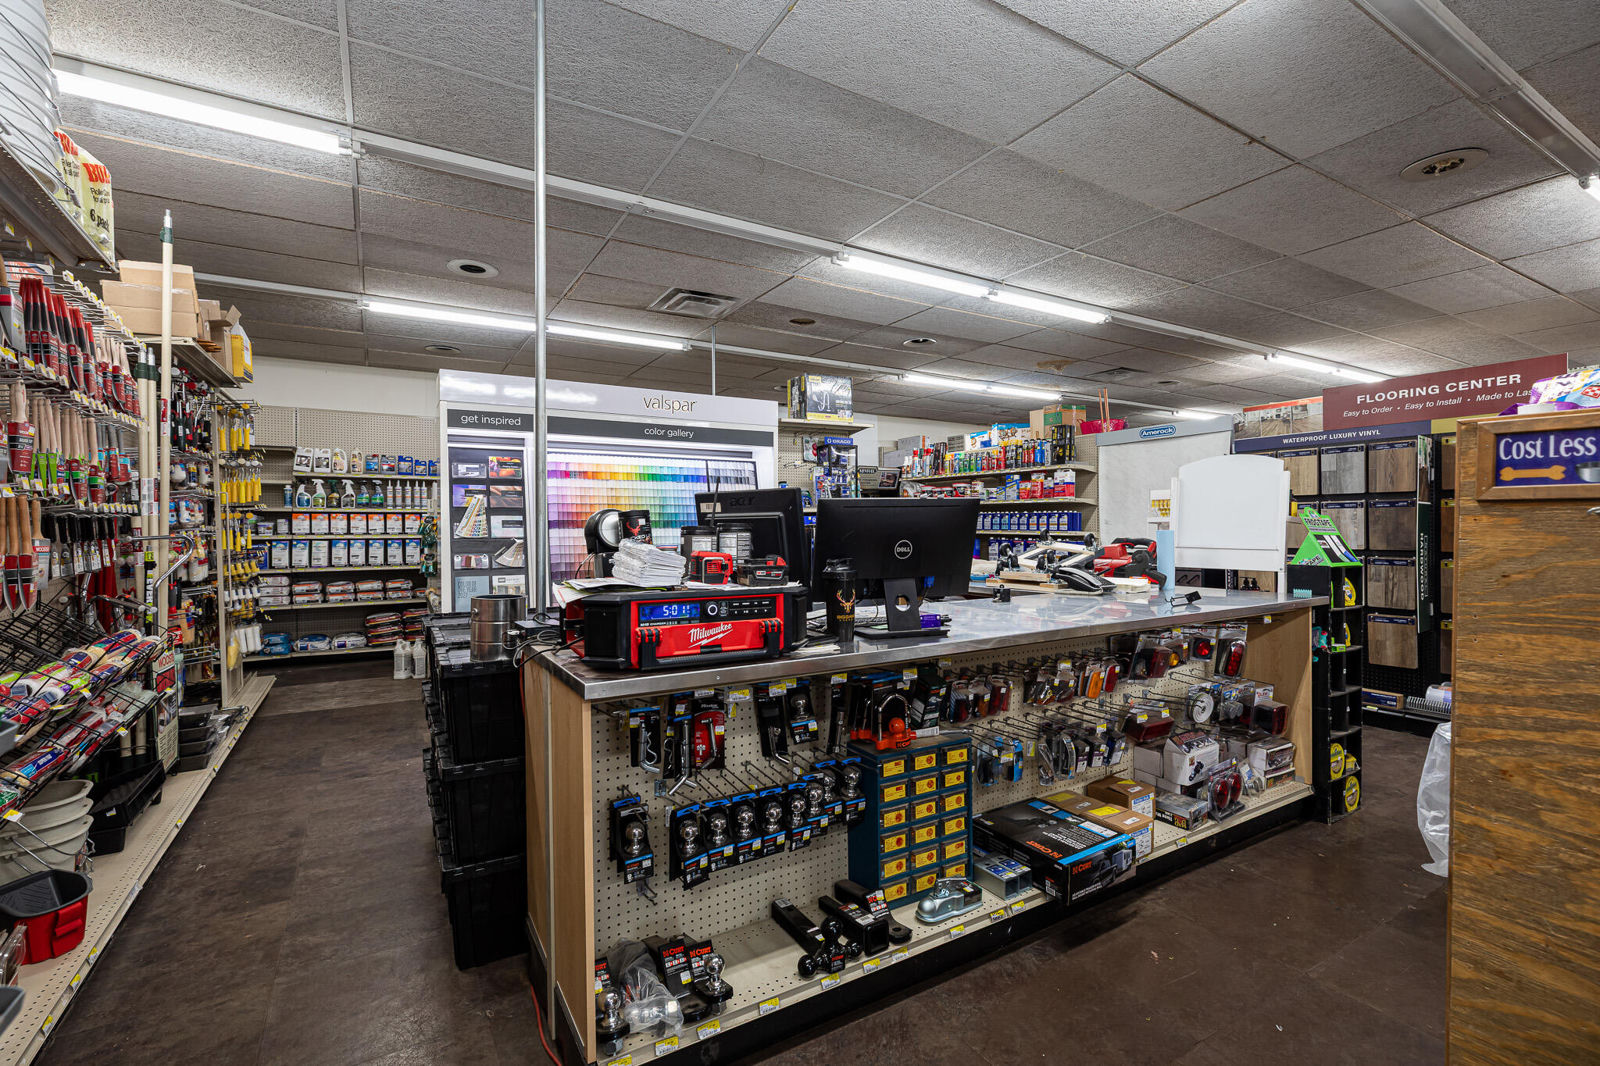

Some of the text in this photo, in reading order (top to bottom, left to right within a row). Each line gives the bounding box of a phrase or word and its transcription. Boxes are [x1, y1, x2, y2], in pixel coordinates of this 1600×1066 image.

[90, 208, 96, 221] 6
[1356, 374, 1521, 404] FLOORING CENTER
[643, 395, 696, 415] valspar
[1343, 410, 1360, 418] Easy
[1371, 405, 1393, 414] Order
[1405, 402, 1424, 410] Easy
[1436, 397, 1462, 407] Install
[1476, 393, 1502, 402] Made
[1504, 390, 1514, 399] to
[1516, 388, 1533, 397] Las
[460, 414, 521, 426] get inspired
[644, 427, 694, 439] color gallery
[1142, 427, 1173, 437] Amerock
[1282, 434, 1327, 444] WATERPROOF
[1329, 432, 1357, 440] LUXURY
[1499, 434, 1597, 461] Cost Less
[688, 623, 733, 643] Milwaukee
